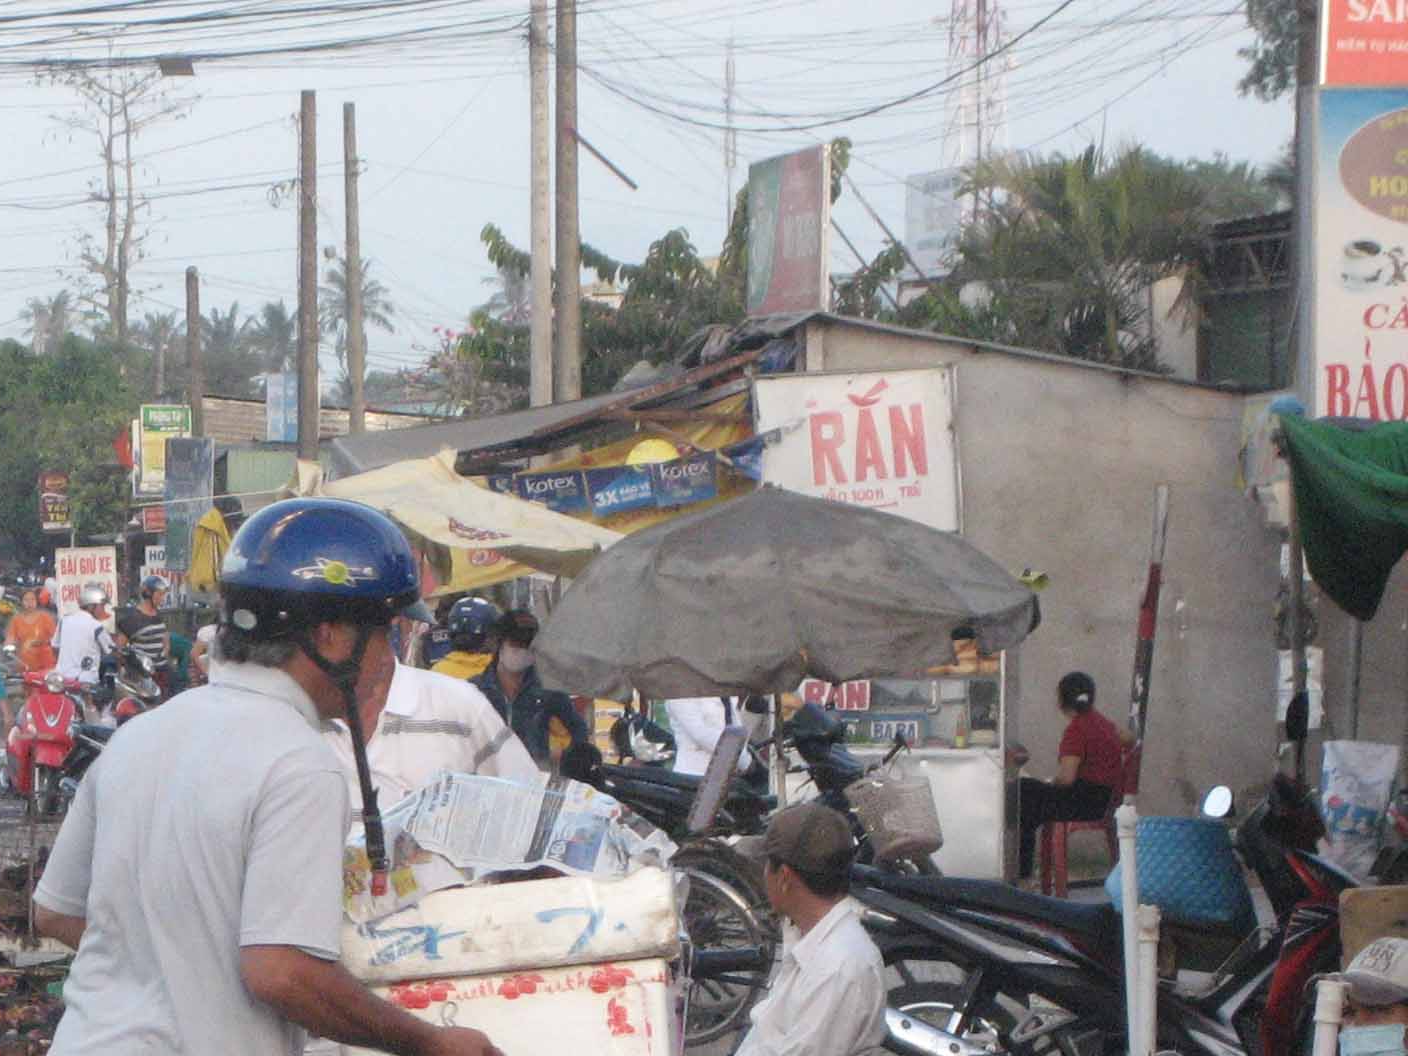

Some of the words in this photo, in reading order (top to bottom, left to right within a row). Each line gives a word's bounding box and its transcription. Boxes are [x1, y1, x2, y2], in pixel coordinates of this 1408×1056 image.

[659, 460, 710, 480] kotex
[525, 474, 577, 494] kotex
[594, 489, 619, 508] 3X
